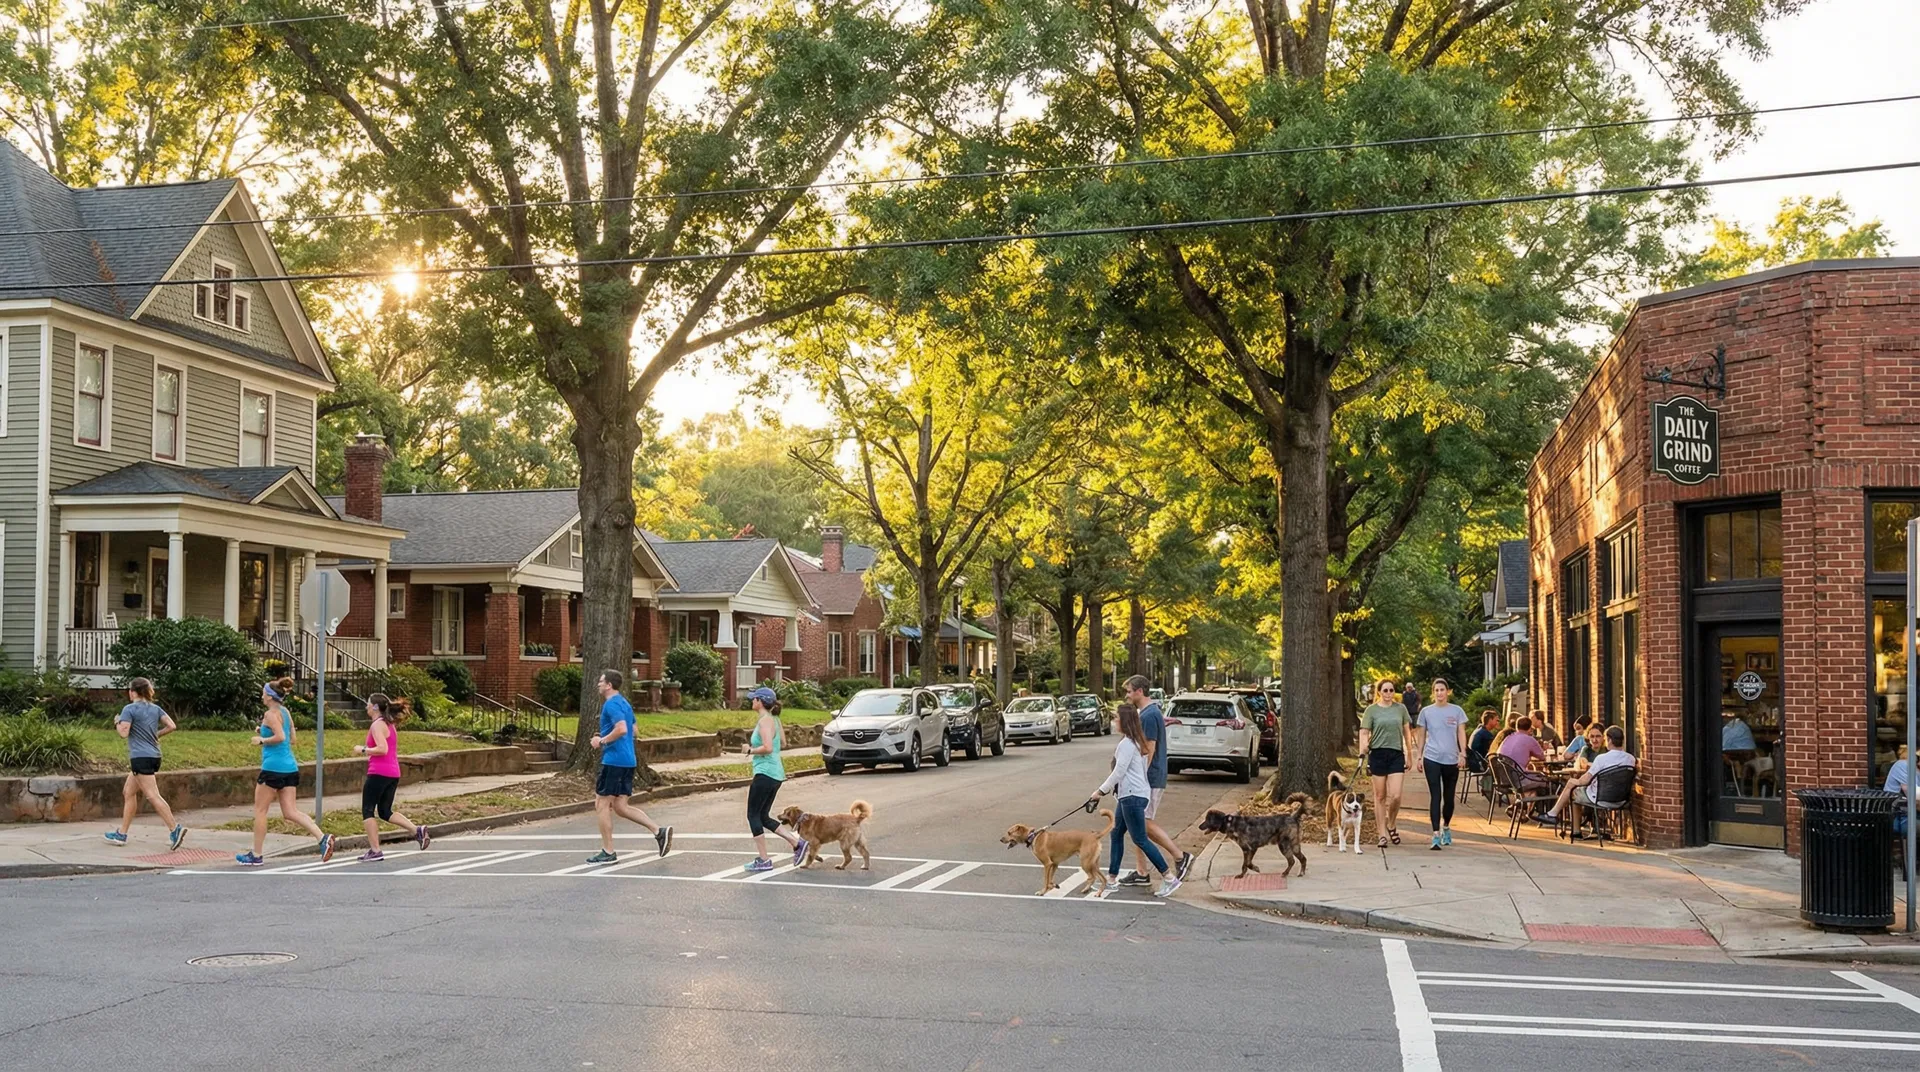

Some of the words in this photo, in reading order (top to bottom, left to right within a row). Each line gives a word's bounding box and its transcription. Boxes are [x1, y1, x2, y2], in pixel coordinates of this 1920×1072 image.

[1678, 405, 1695, 416] THE
[1664, 416, 1709, 440] DAILY
[1663, 439, 1712, 463] GRIND
[1674, 463, 1701, 475] COFFEE
